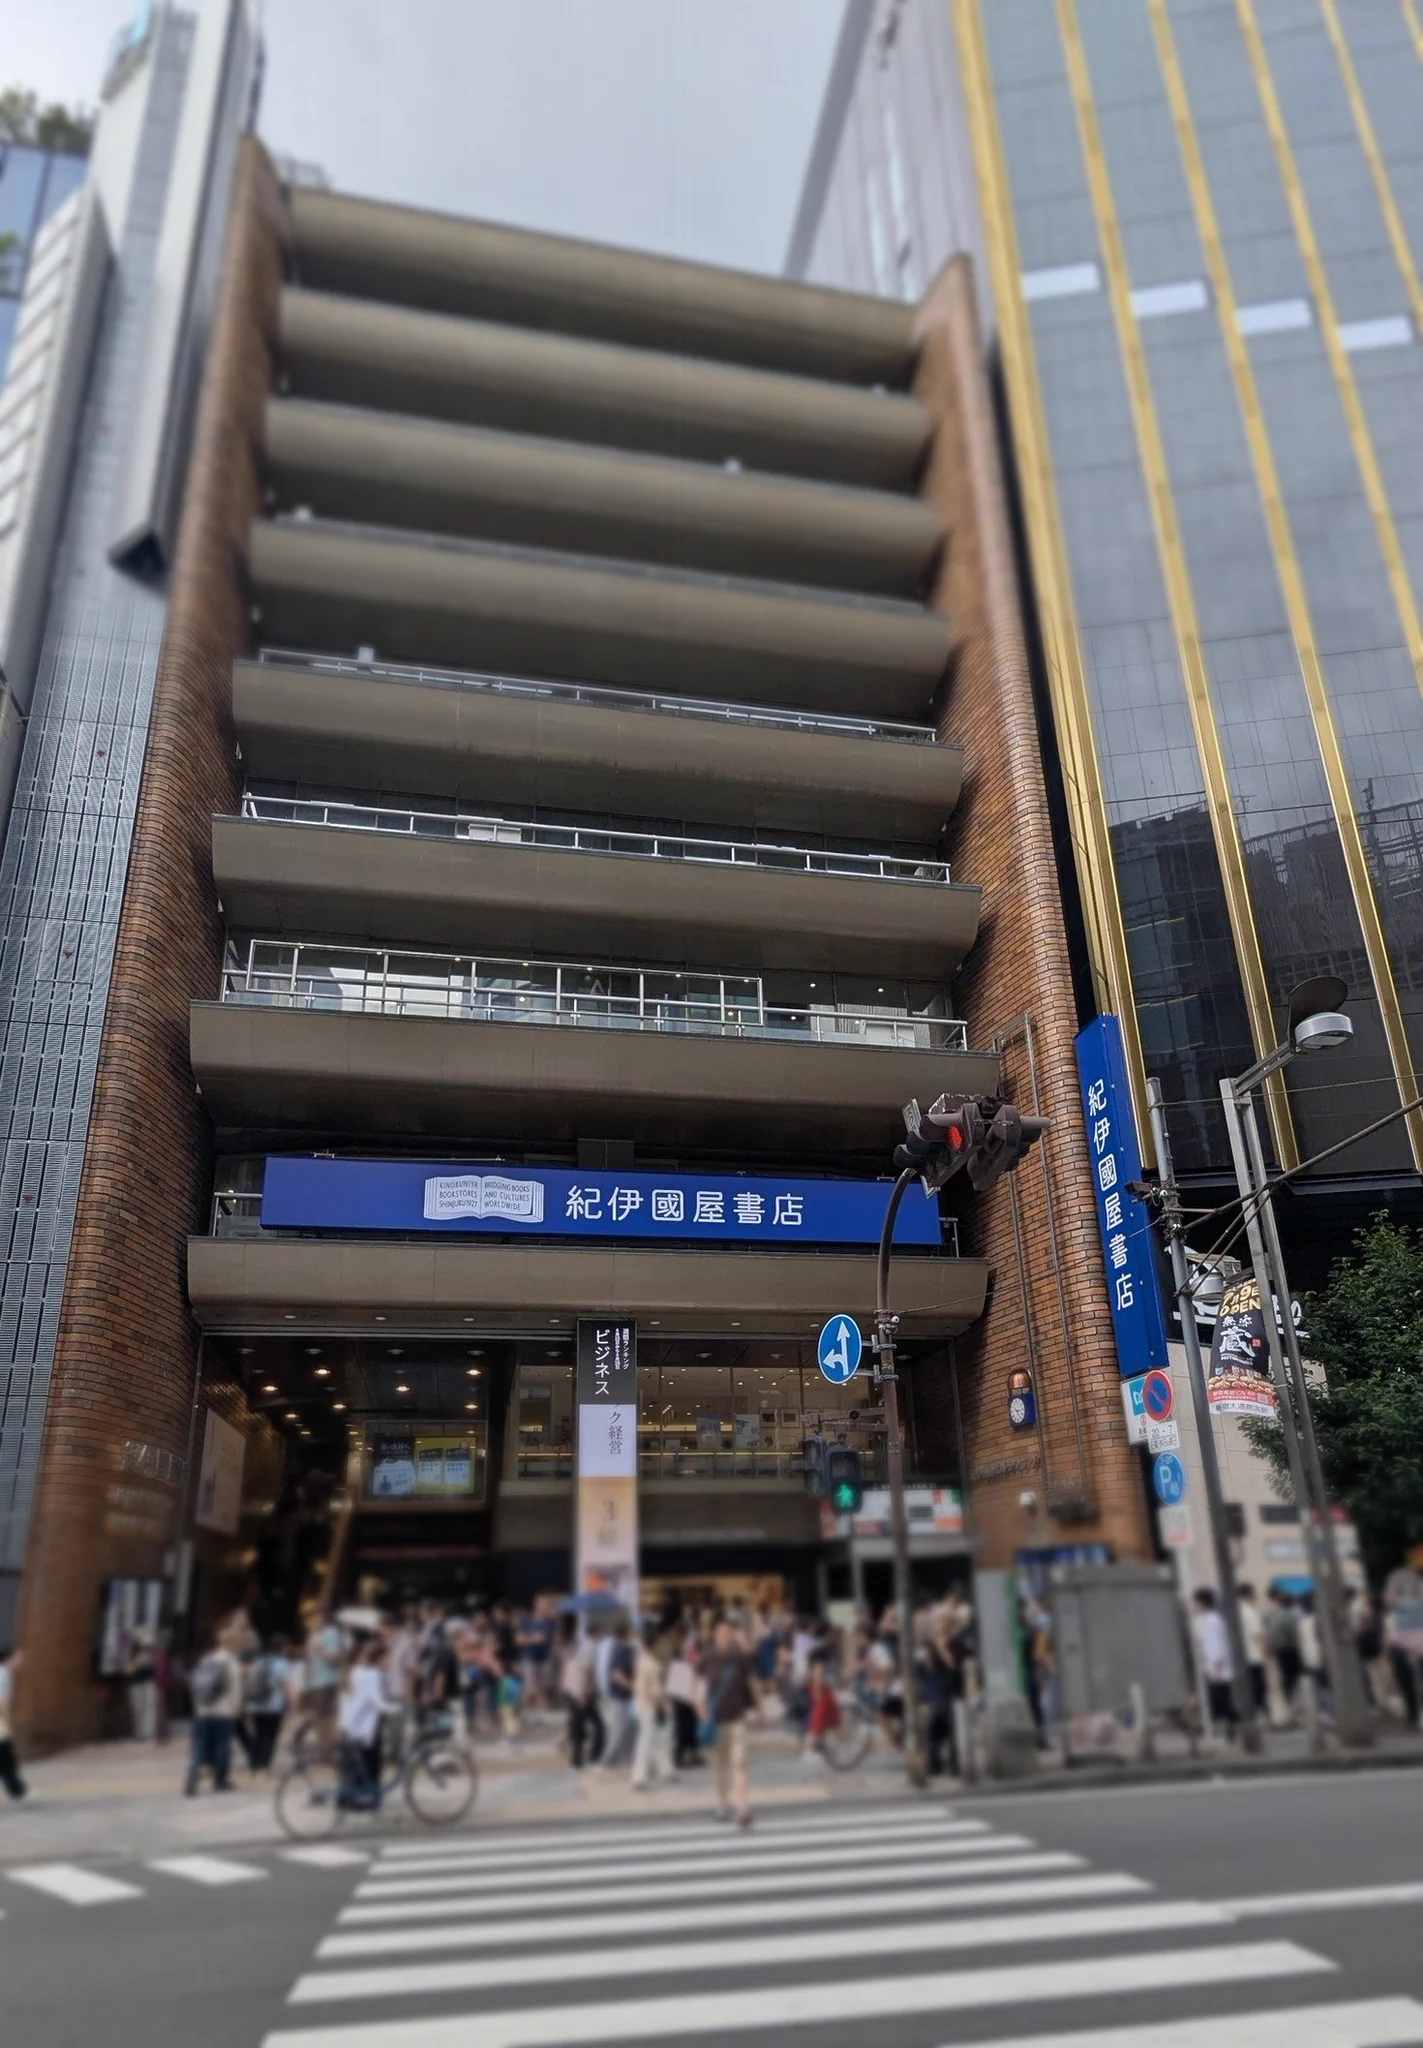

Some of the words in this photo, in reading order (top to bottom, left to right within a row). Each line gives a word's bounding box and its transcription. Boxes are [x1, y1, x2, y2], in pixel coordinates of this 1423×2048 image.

[439, 1181, 479, 1189] KINOKUNIYA
[484, 1181, 511, 1192] BRIDGING
[511, 1185, 530, 1193] BOOKS
[439, 1189, 478, 1199] BOOKSTORES
[484, 1190, 498, 1198] AND
[499, 1191, 530, 1202] CULTURES
[1087, 1077, 1135, 1312] 紀伊國屋書店
[439, 1199, 467, 1209] SHINJUKU
[466, 1199, 478, 1208] 1927
[484, 1199, 521, 1211] WORLDWIDE
[564, 1184, 804, 1226] 紀伊國屋書店
[1219, 1297, 1262, 1317] OPEN
[594, 1328, 611, 1395] ビジネス
[1159, 1465, 1172, 1498] P
